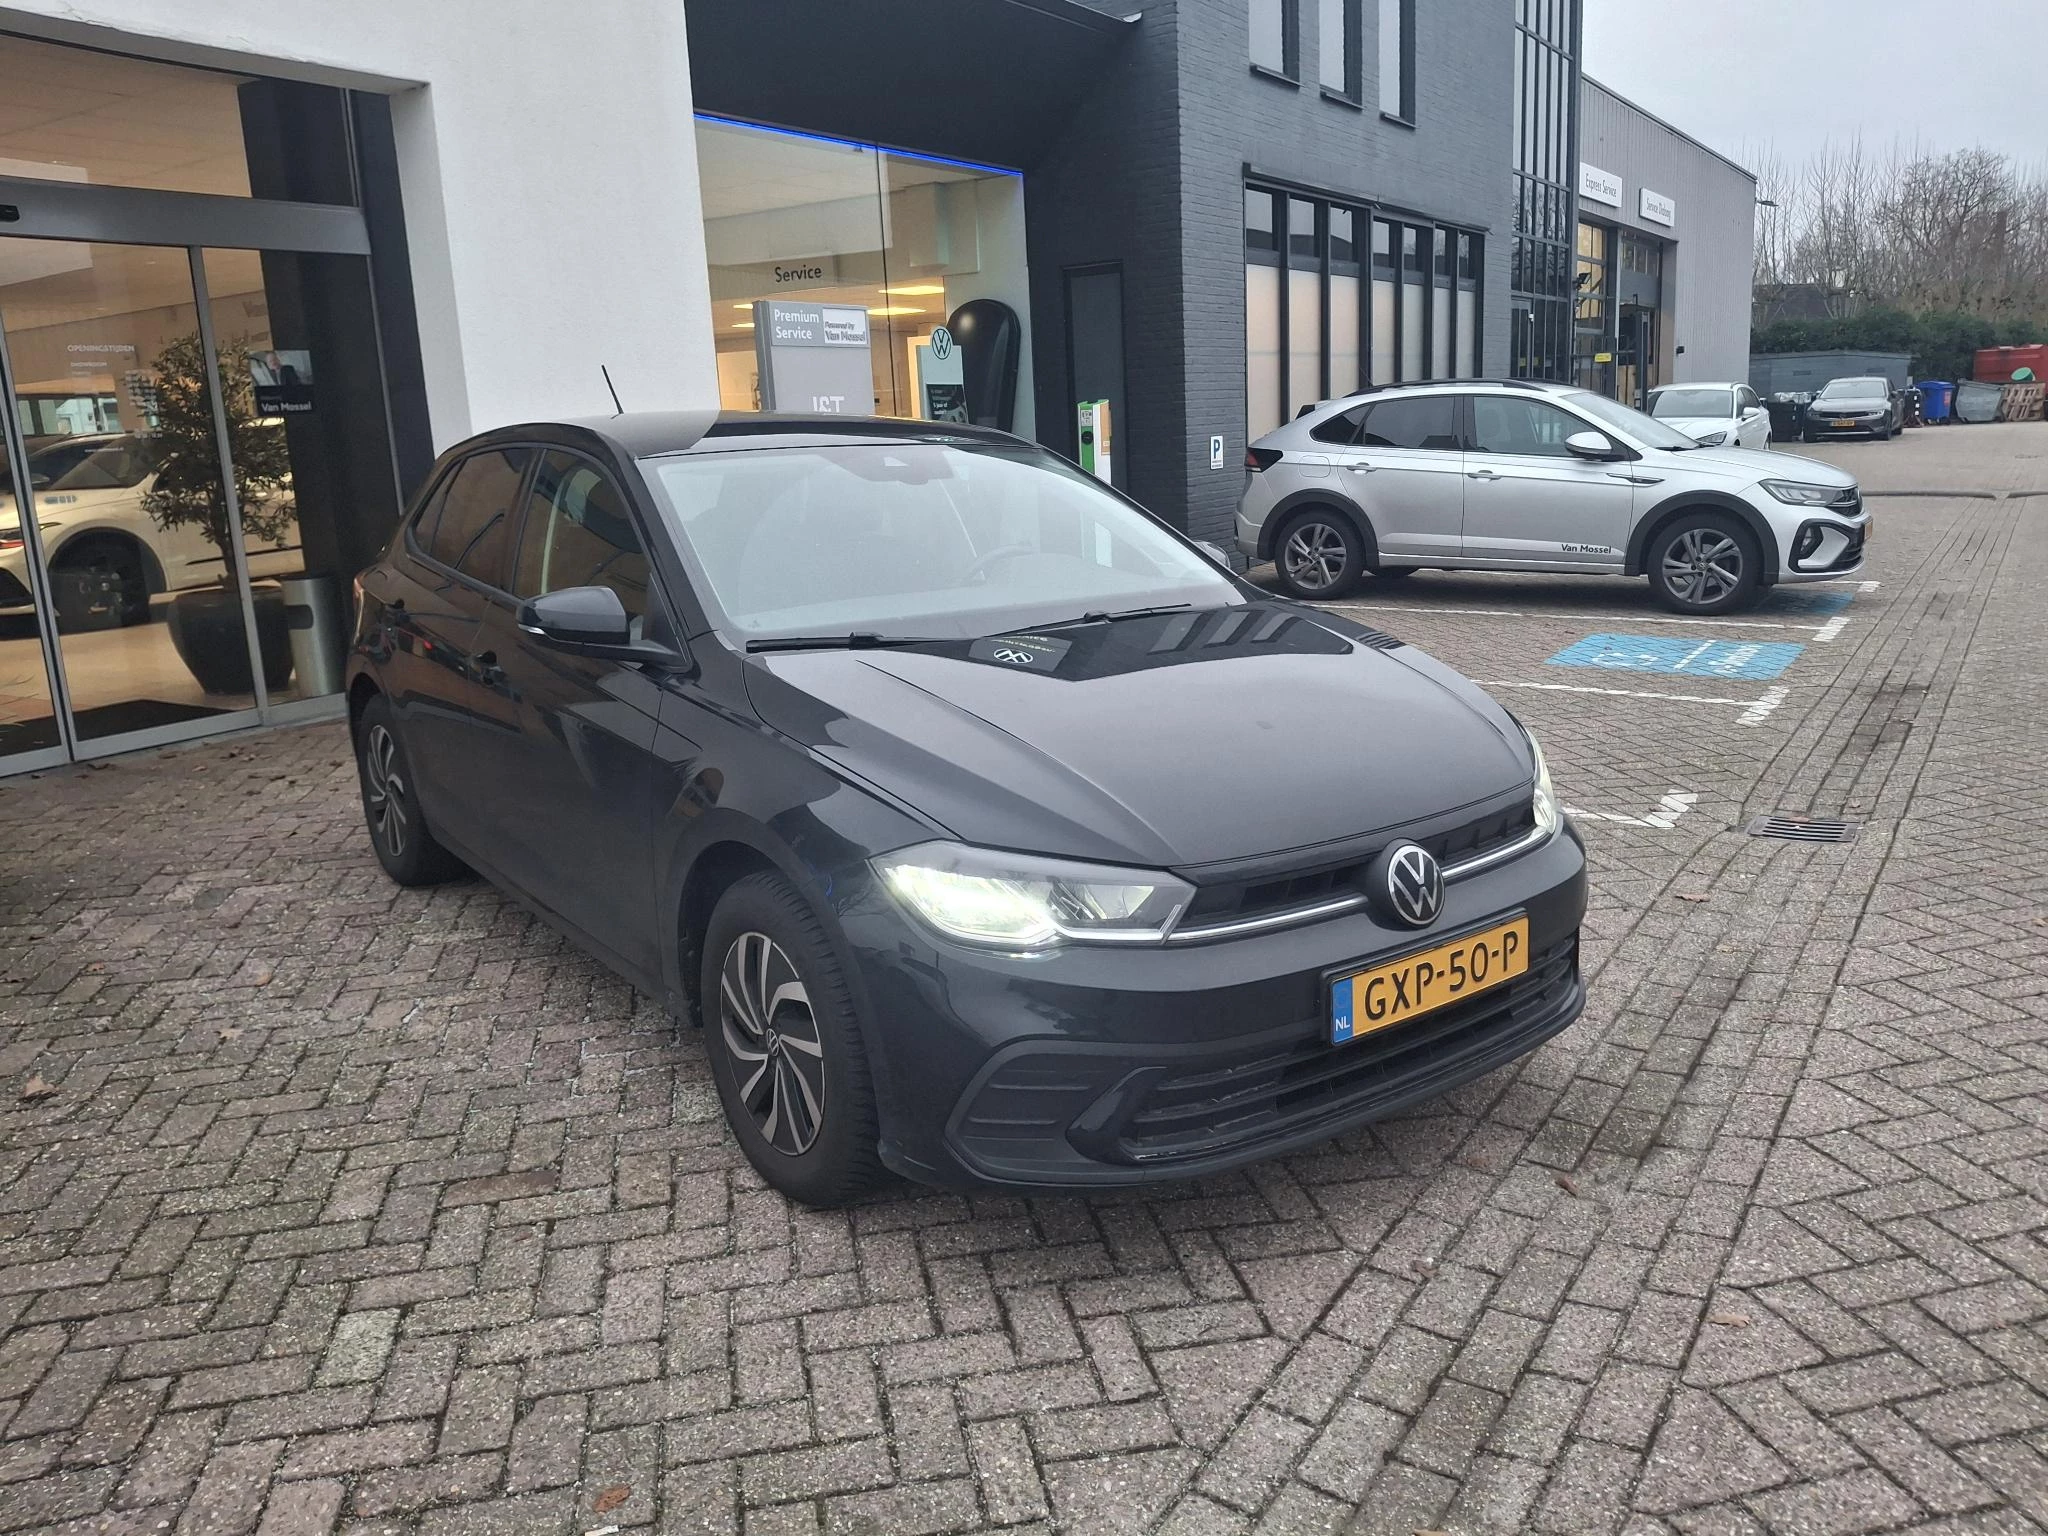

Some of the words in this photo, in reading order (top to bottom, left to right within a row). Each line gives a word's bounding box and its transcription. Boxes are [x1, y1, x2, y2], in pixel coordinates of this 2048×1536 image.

[1585, 173, 1602, 193] Express
[1602, 179, 1617, 198] Service
[1646, 197, 1658, 214] Service
[774, 264, 822, 283] Service
[774, 309, 820, 323] Premium
[824, 321, 847, 329] Powered
[848, 322, 856, 330] by
[776, 326, 812, 340] Service
[825, 330, 840, 341] Van
[841, 330, 866, 342] Mossel
[261, 402, 279, 412] Van
[280, 400, 313, 412] Mossel
[1213, 439, 1221, 459] P
[1561, 543, 1578, 552] Van
[1580, 544, 1612, 554] Mossel
[1335, 1015, 1350, 1032] NL
[1364, 930, 1519, 1021] GXP-50-P
